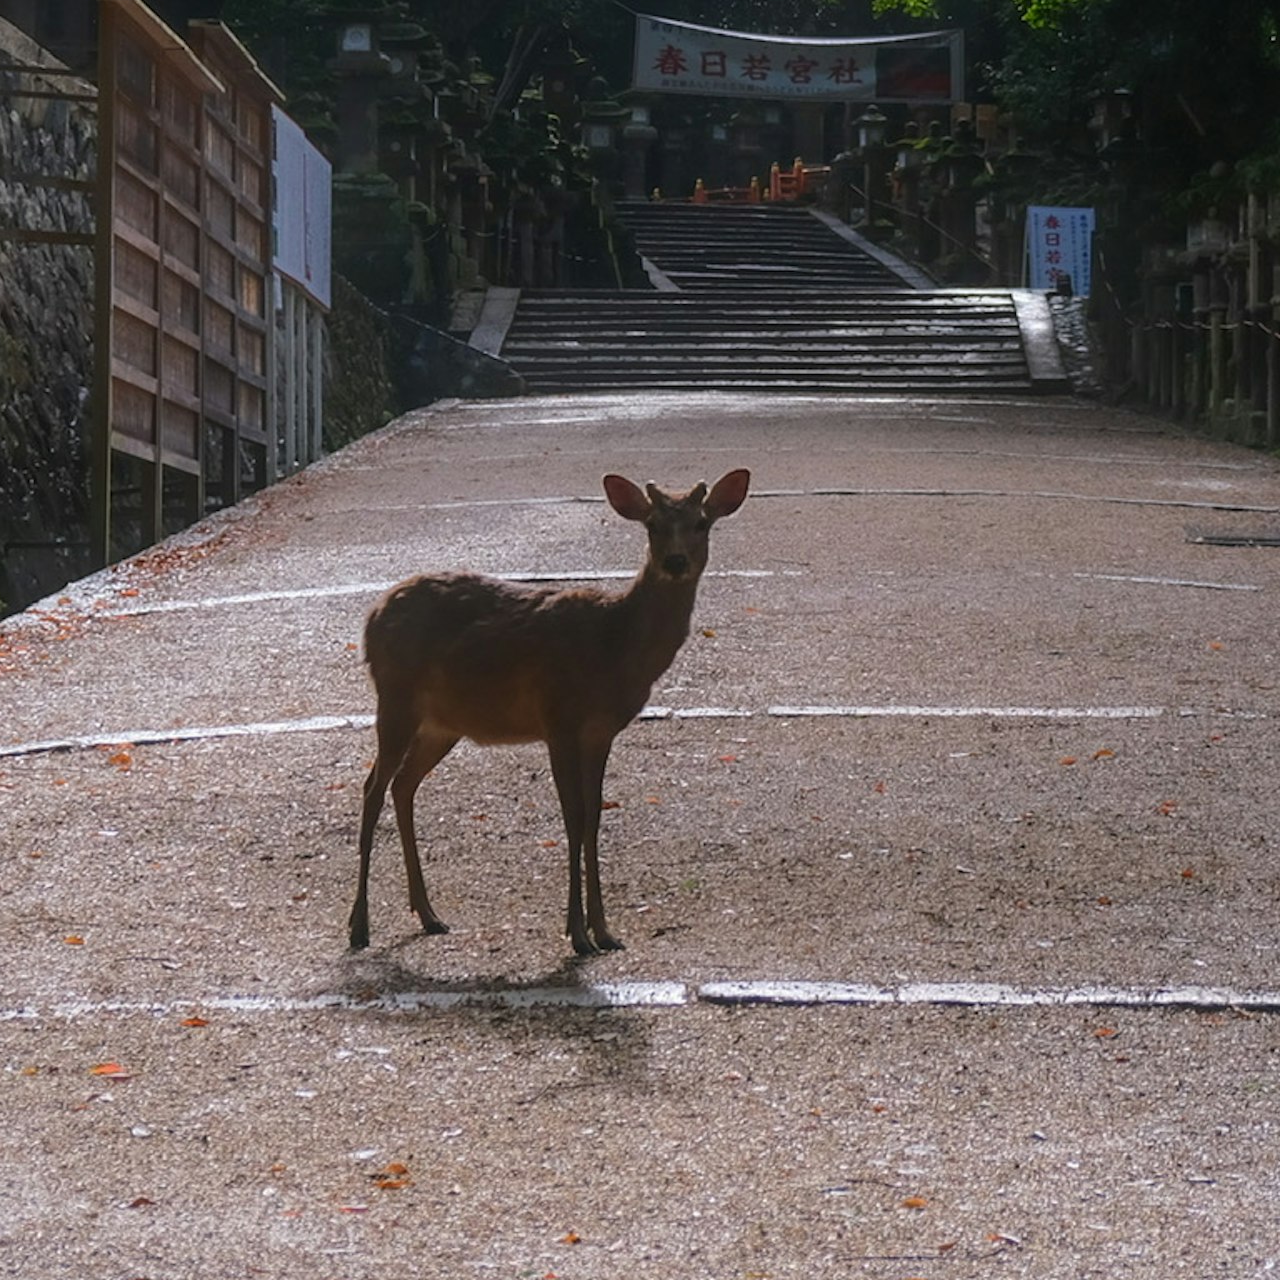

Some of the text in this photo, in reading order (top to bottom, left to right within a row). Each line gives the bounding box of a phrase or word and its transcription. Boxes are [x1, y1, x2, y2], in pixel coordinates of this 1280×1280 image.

[653, 45, 863, 85] 春日若宮社
[1043, 214, 1063, 288] 春日若宮
